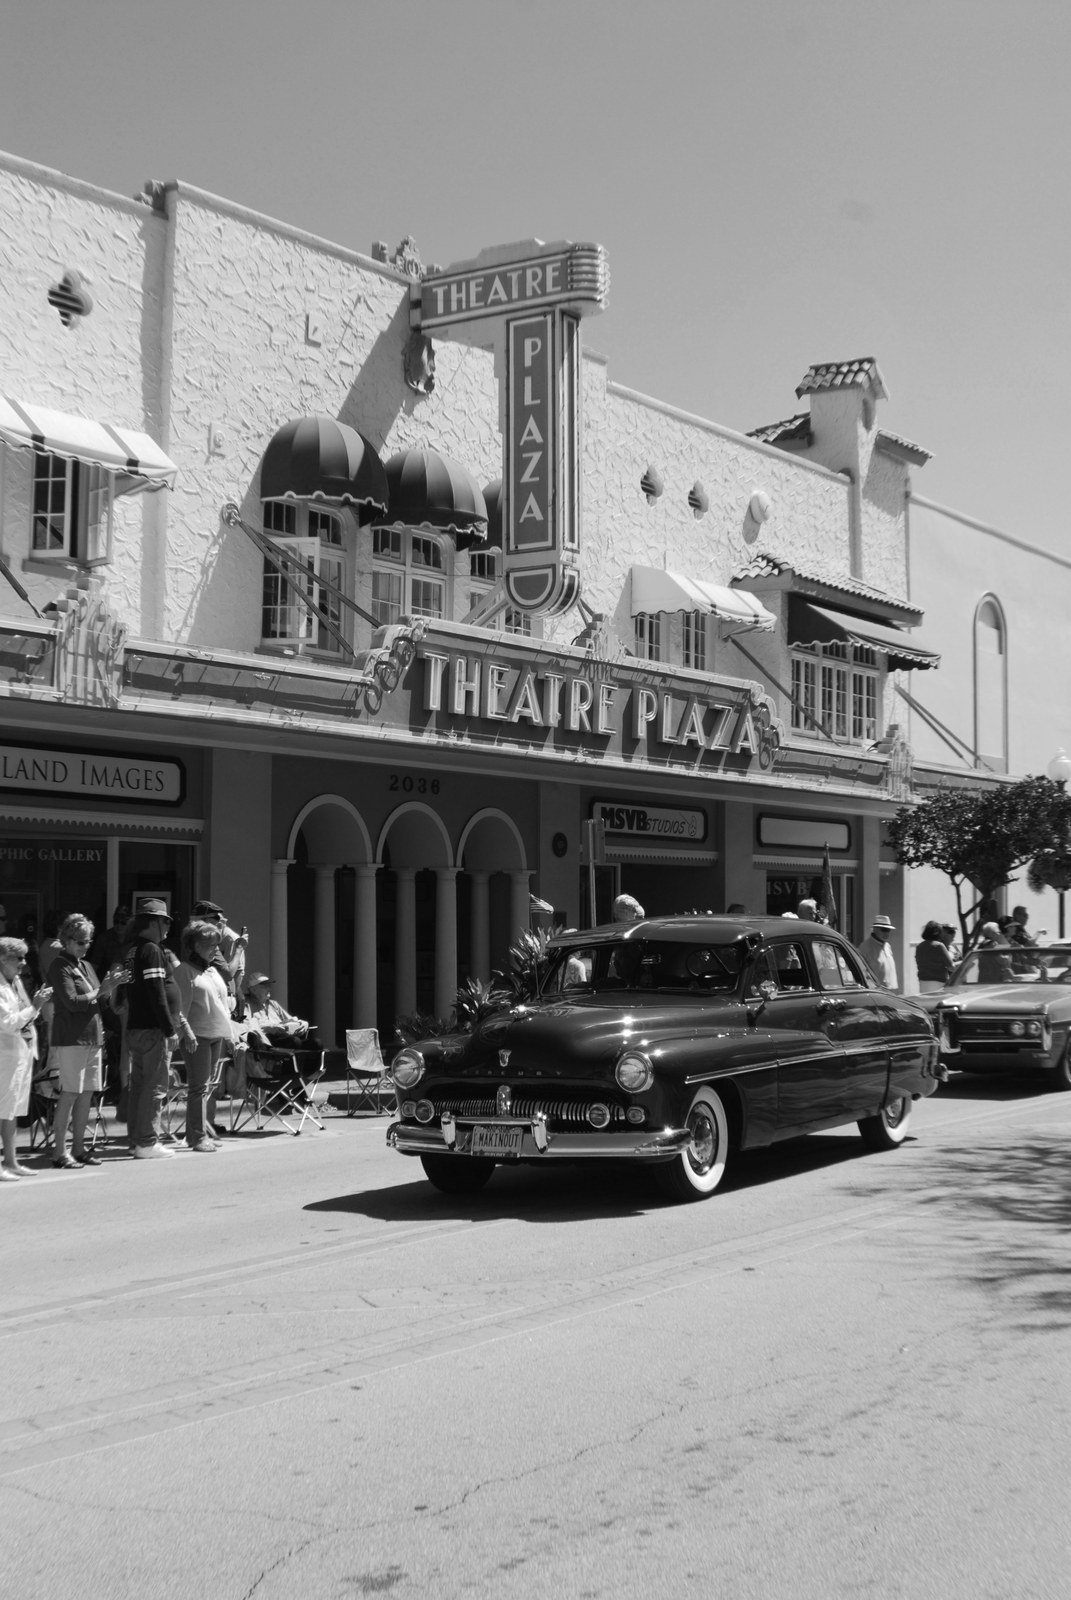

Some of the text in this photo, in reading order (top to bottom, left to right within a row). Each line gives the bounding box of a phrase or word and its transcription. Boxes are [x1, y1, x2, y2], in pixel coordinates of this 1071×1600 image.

[432, 262, 562, 315] THEATRE
[519, 337, 544, 523] PLAZA
[418, 650, 758, 755] THEATRE PLAZA
[2, 756, 165, 792] LAND IMAGES
[389, 774, 440, 795] 2036
[600, 806, 686, 835] MSVB STUDIOS
[38, 848, 104, 862] GALLERY
[767, 881, 808, 896] SVB
[479, 1133, 519, 1148] MAKINOUT
